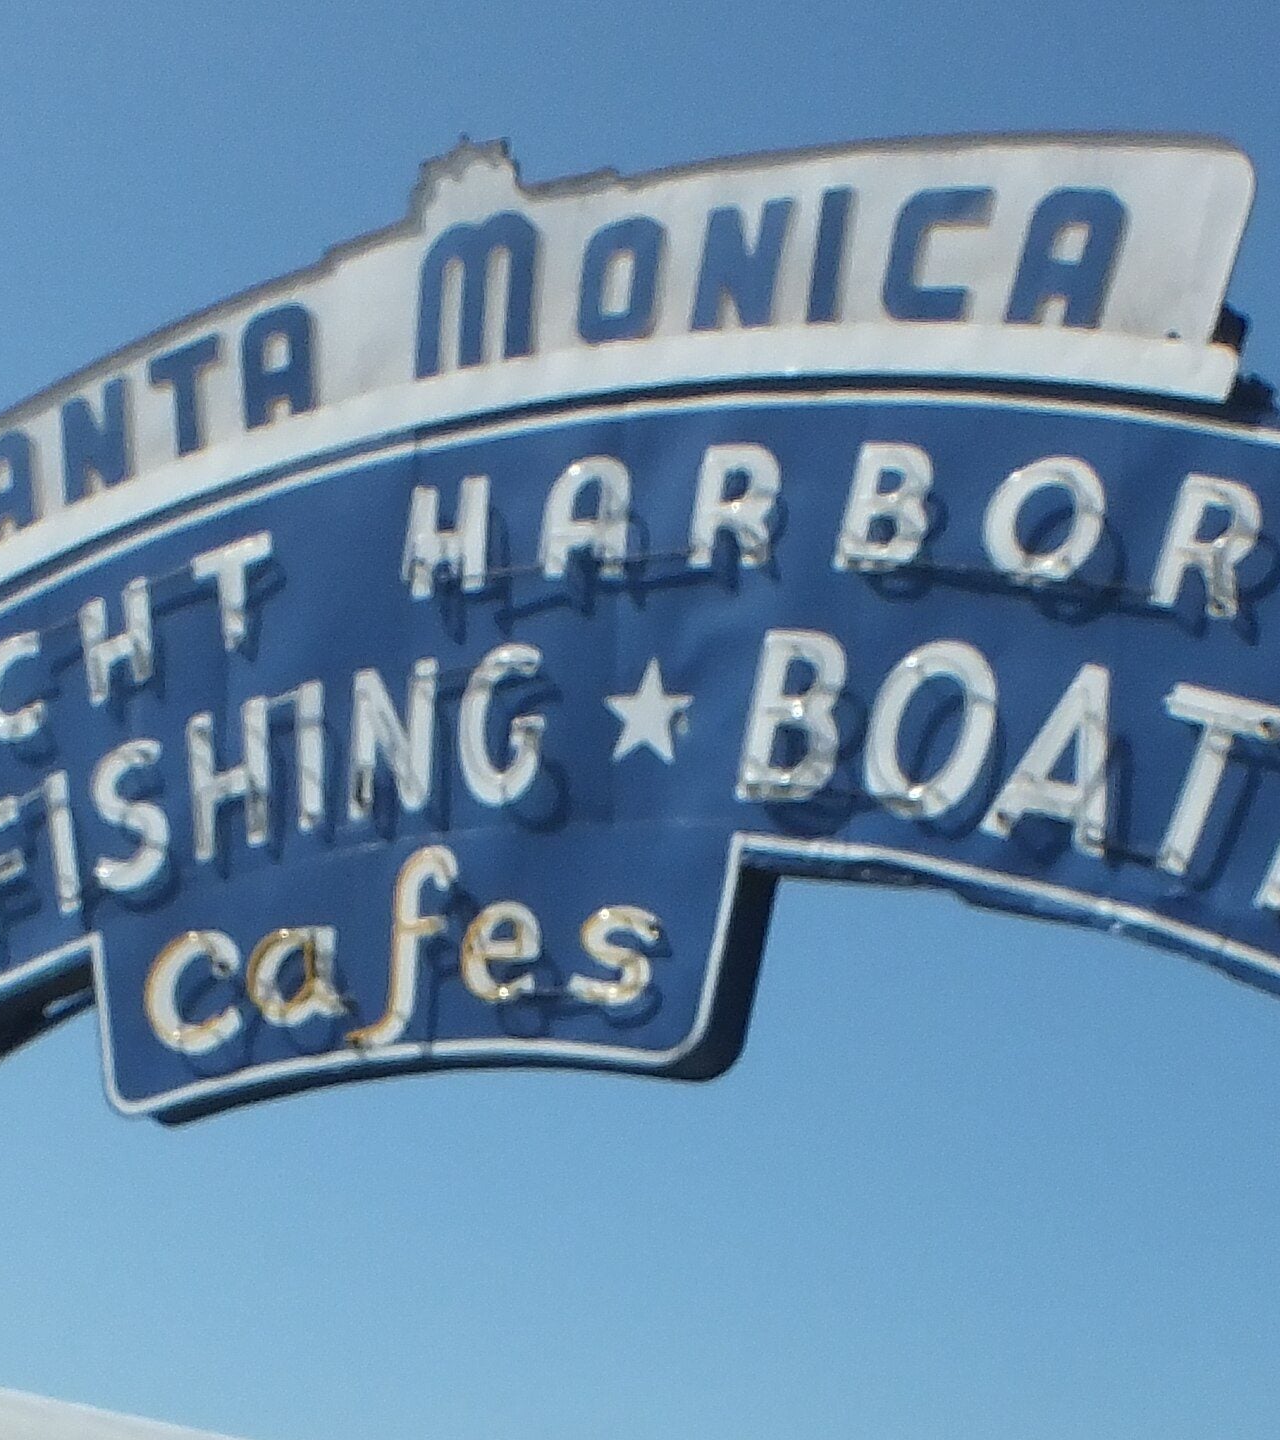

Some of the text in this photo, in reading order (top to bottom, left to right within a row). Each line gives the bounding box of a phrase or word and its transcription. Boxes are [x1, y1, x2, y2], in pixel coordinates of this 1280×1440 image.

[413, 186, 1128, 379] MONICA
[401, 441, 1265, 621] HARBOR
[144, 845, 661, 1055] cafes
